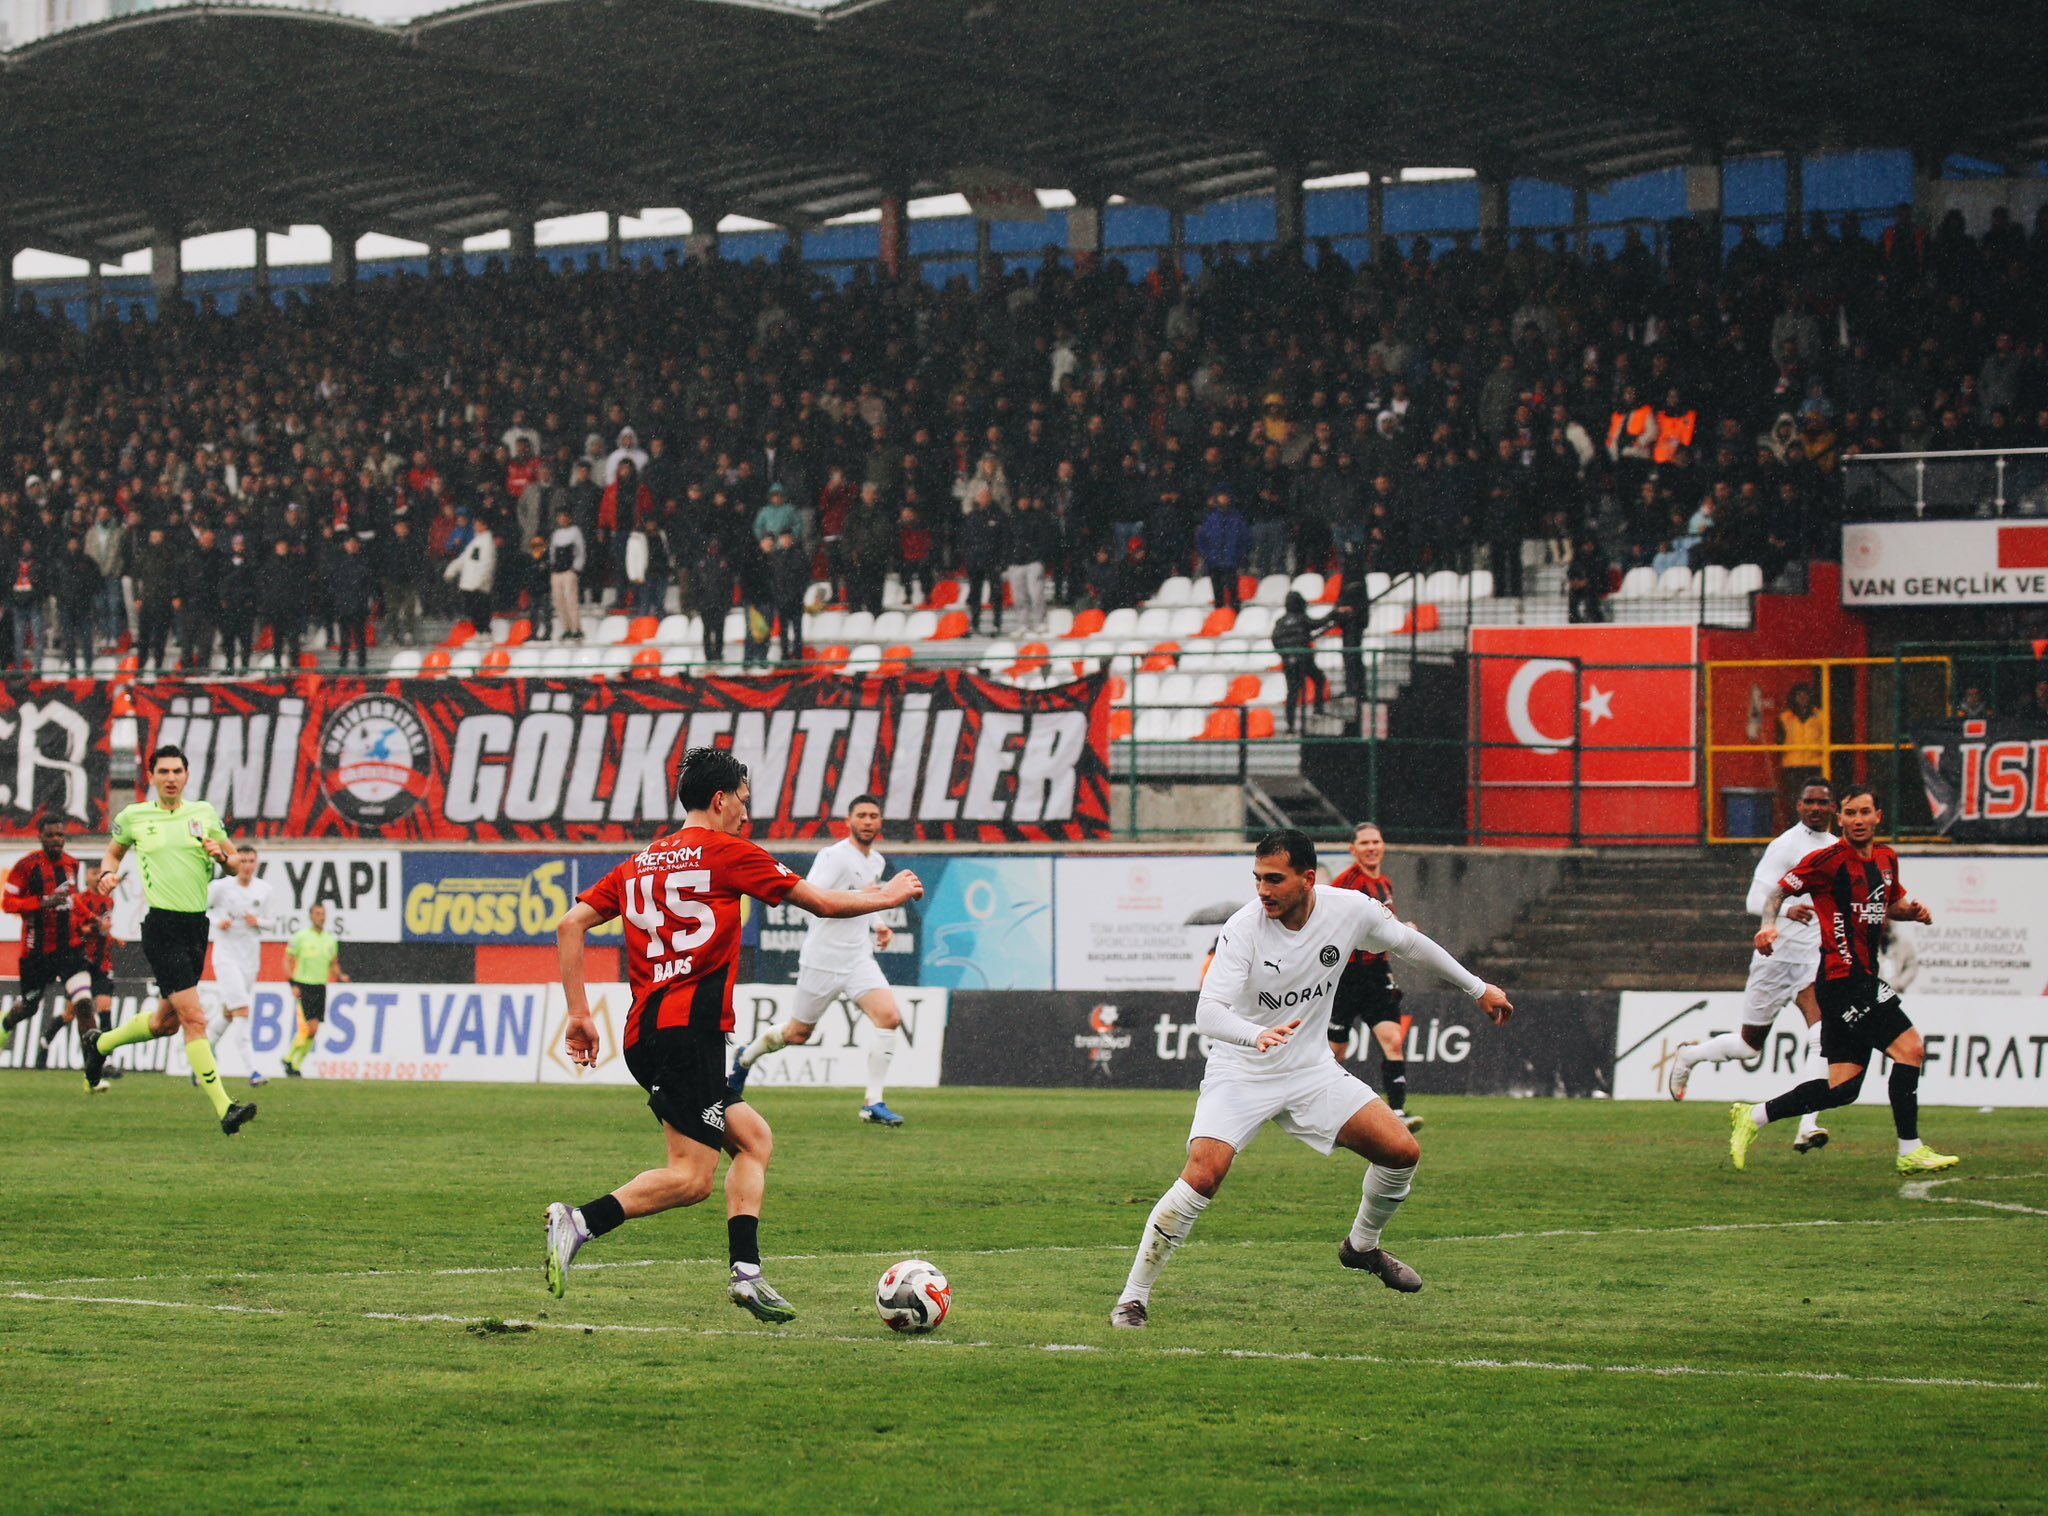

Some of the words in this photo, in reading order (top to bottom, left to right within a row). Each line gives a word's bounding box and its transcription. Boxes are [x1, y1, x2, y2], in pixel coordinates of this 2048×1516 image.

[1850, 578, 1895, 597] VAN
[1904, 572, 2008, 598] GENÇLİK
[2017, 575, 2046, 593] VE
[286, 862, 387, 909] YAPI
[625, 870, 716, 958] 45
[250, 992, 398, 1054] BST
[419, 993, 534, 1056] VAN
[1406, 1017, 1472, 1063] LİG
